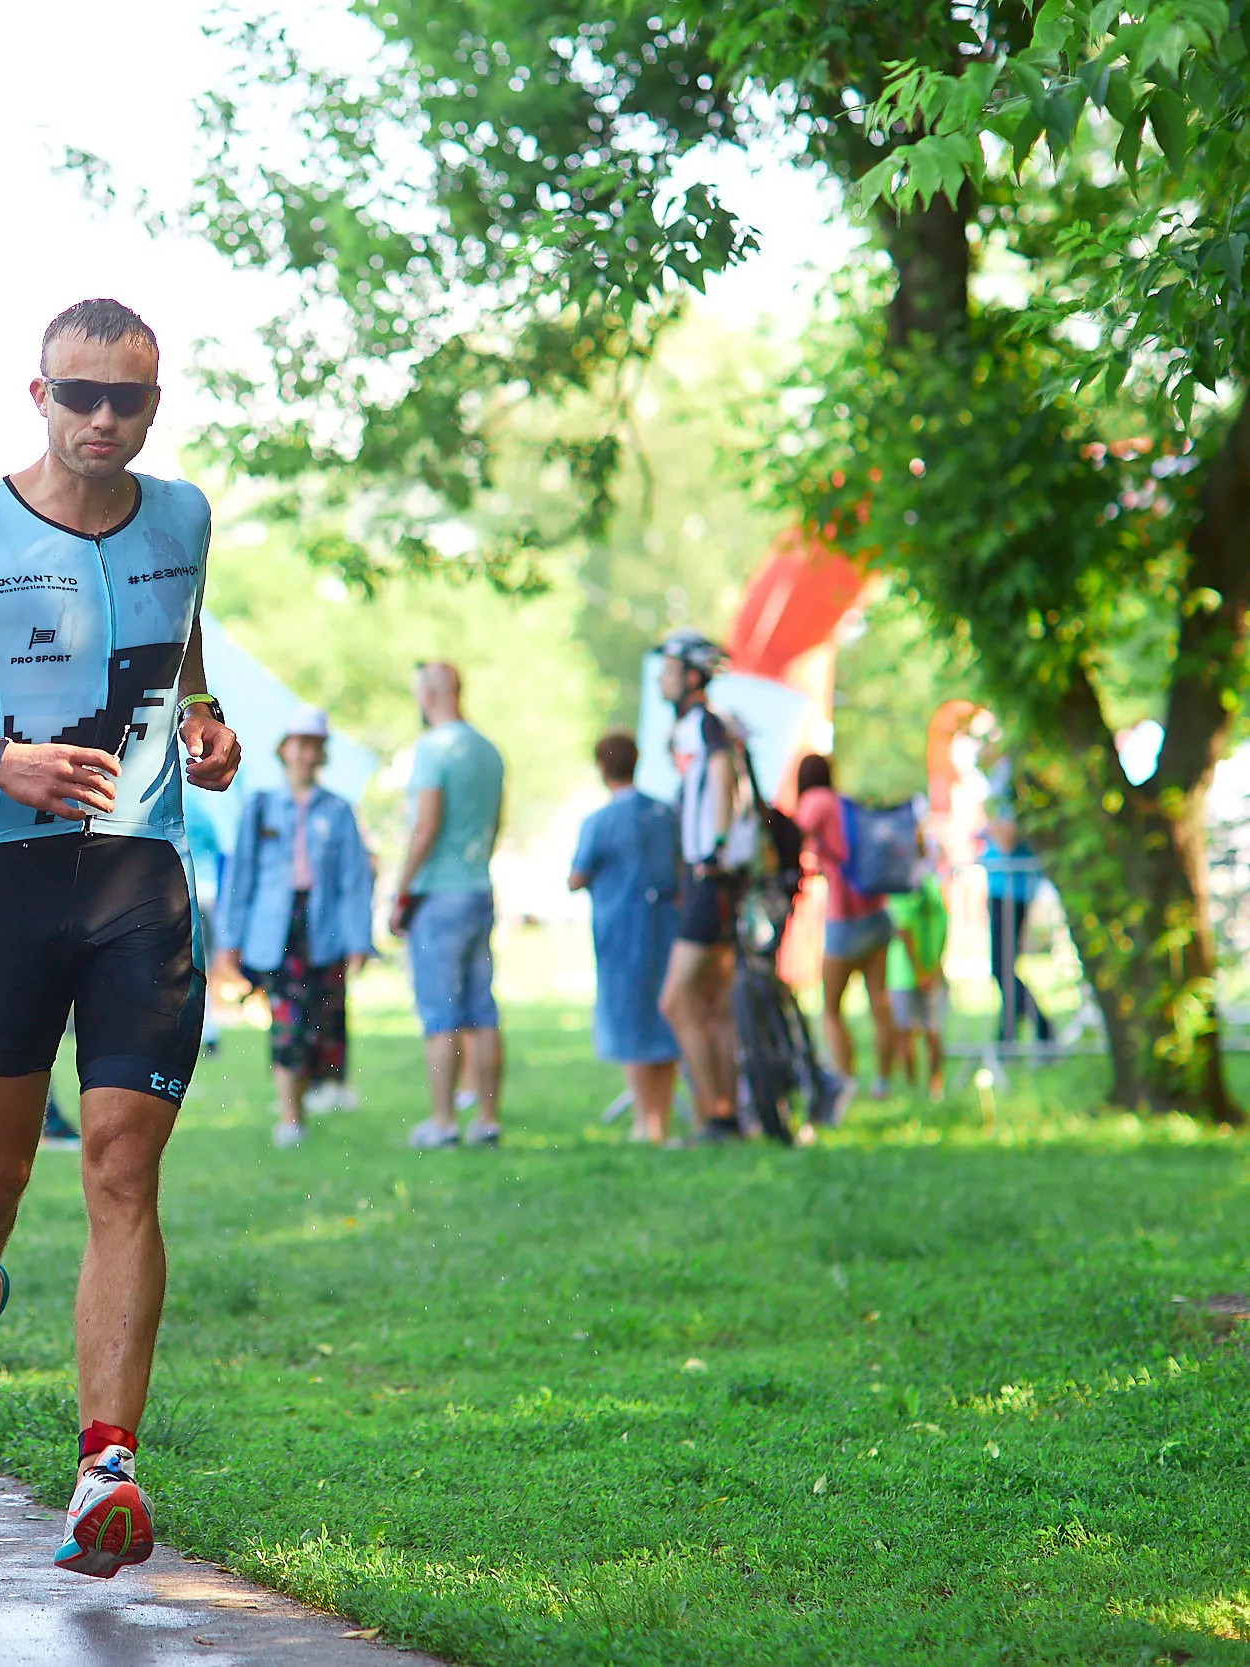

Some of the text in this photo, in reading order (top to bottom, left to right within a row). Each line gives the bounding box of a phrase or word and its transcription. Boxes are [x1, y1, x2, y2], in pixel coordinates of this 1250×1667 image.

[58, 576, 78, 585] VD
[47, 585, 78, 593] company
[10, 655, 71, 664] PRO SPORT
